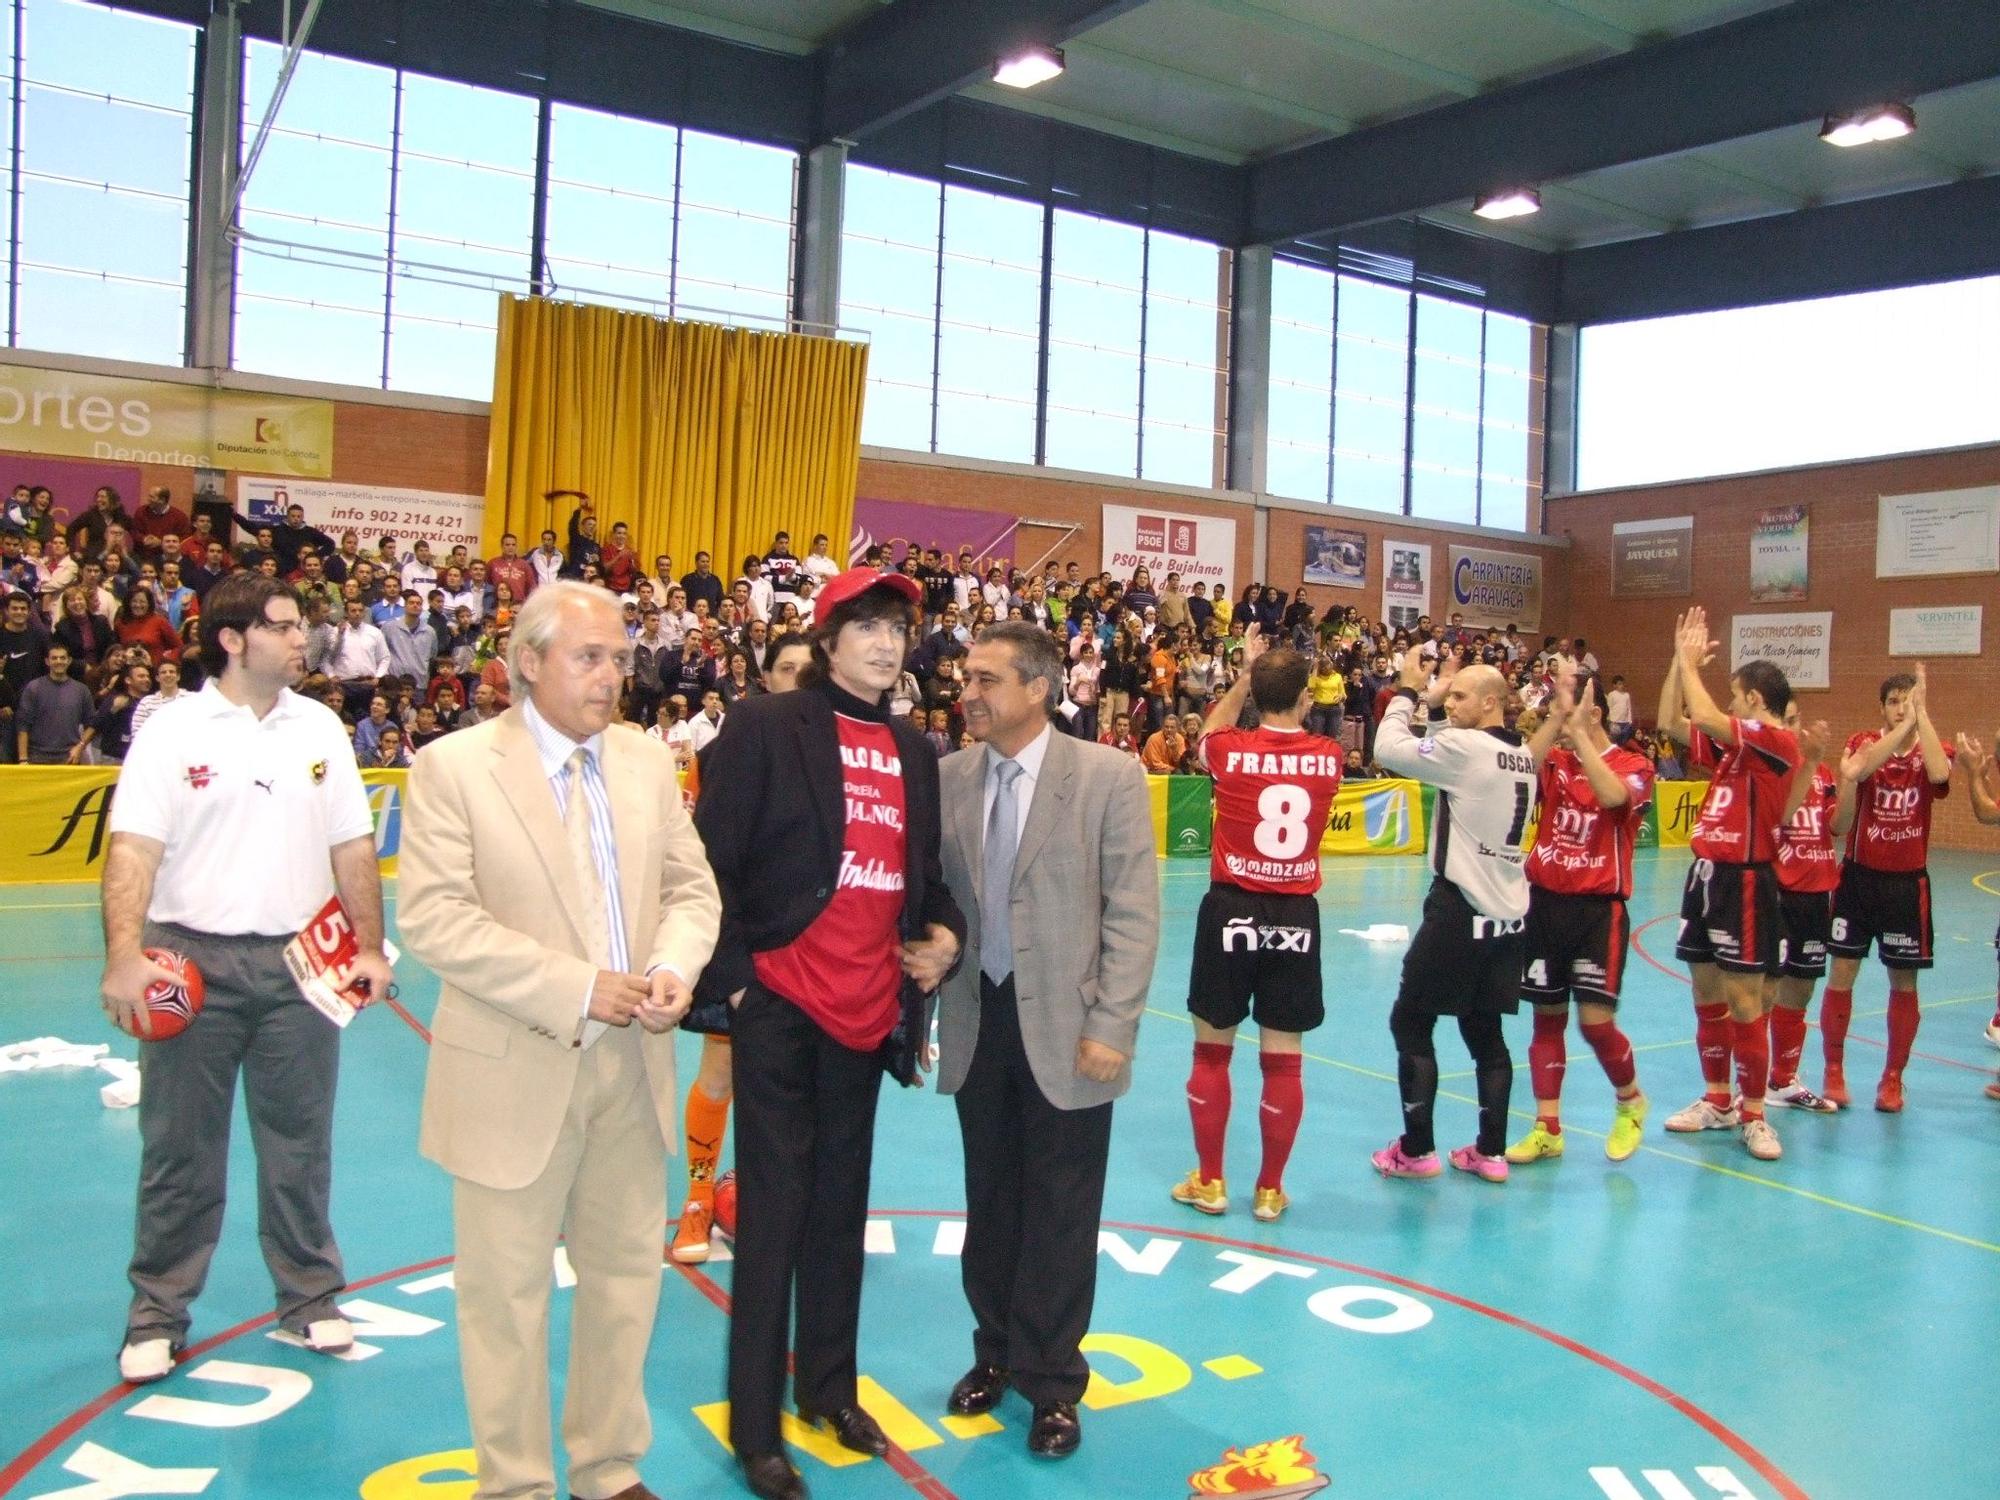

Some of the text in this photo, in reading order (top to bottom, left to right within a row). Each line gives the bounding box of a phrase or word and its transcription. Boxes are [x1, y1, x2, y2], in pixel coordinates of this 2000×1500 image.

[93, 441, 210, 467] Deportes
[217, 443, 267, 455] Diputación
[331, 506, 463, 528] info 902 214 421
[315, 521, 479, 545] www.gruponxxi.com
[1138, 535, 1162, 547] PSOE
[1112, 552, 1224, 577] PSOE de Bujalance
[1739, 625, 1823, 639] CONSTRUCCIONES
[1739, 644, 1761, 659] Juan
[1226, 752, 1337, 777] FRANCIS
[1505, 781, 1529, 846] 1
[1874, 787, 1919, 816] mp
[1253, 784, 1311, 860] 8
[1881, 825, 1923, 843] CajaSur
[1247, 859, 1317, 877] MANZANO
[1552, 848, 1606, 871] CajaSur
[313, 910, 350, 954] 5
[1831, 917, 1848, 942] 6
[1527, 958, 1548, 986] 4
